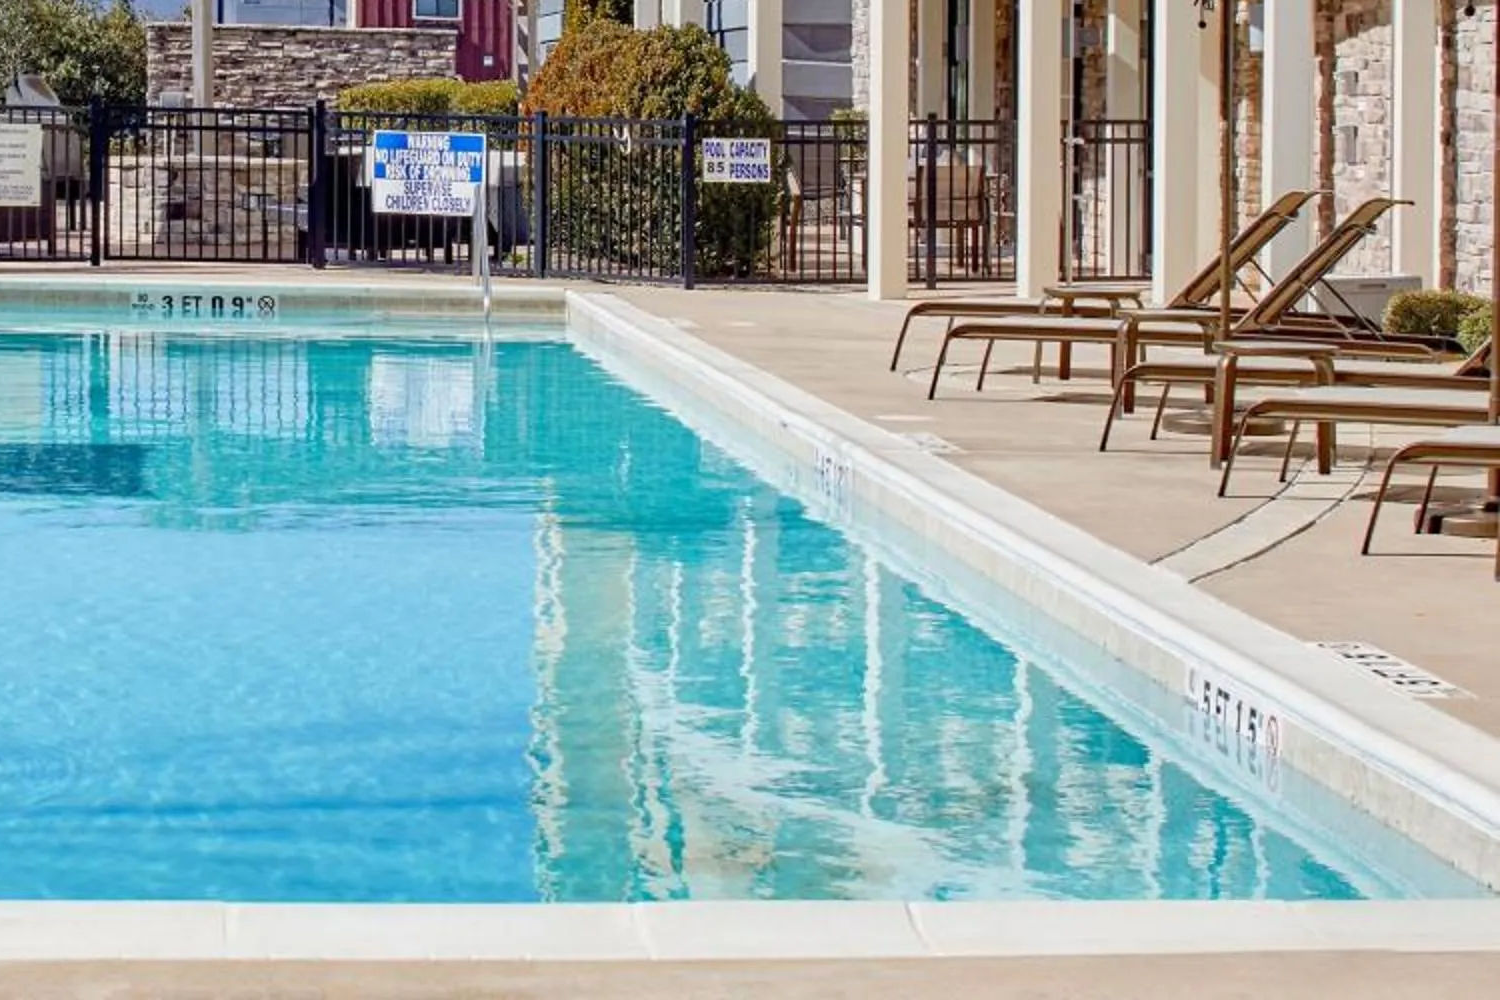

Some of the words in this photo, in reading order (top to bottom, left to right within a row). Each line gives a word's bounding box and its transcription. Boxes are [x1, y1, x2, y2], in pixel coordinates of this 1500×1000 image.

[705, 142, 725, 157] POOL
[729, 142, 768, 158] CAPACITY
[375, 149, 389, 163] NO
[390, 149, 440, 165] LIFEGUARD
[442, 151, 454, 166] ON
[457, 152, 482, 168] DUTY
[386, 164, 407, 180] RISK
[409, 165, 421, 180] OF
[707, 161, 725, 173] 85
[729, 163, 768, 178] PERSONS
[403, 181, 453, 197] SUPERVISE
[385, 195, 430, 211] CHILDREN
[431, 197, 471, 213] CLOSELY
